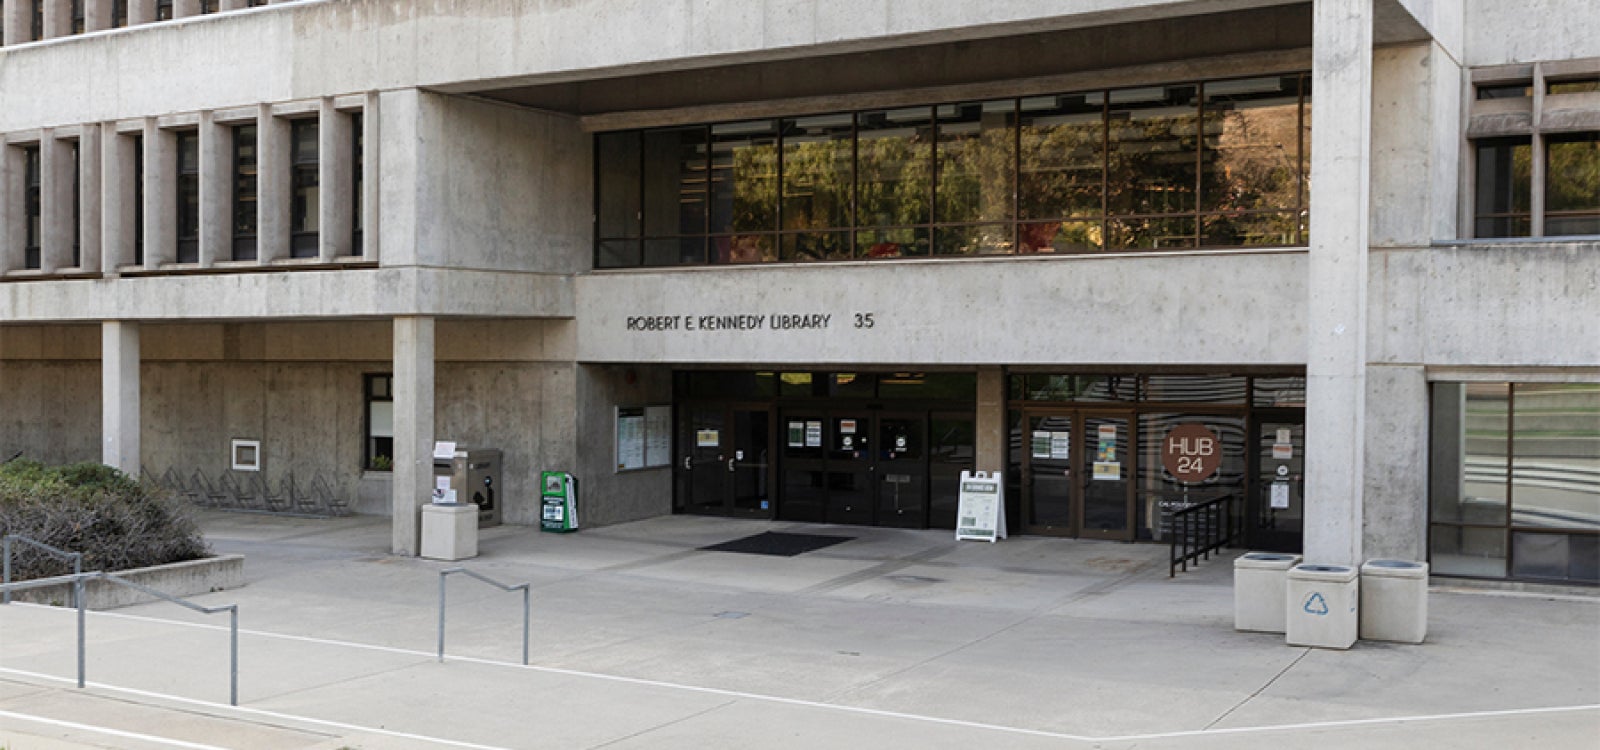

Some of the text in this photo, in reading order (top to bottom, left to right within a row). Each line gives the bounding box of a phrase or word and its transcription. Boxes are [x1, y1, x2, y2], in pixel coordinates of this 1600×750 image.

[626, 315, 681, 331] ROBERT
[699, 314, 765, 331] KENNEDY
[769, 313, 832, 330] LIBRARY
[854, 312, 875, 329] 35
[1169, 437, 1214, 456] HUB
[1176, 456, 1203, 474] 24
